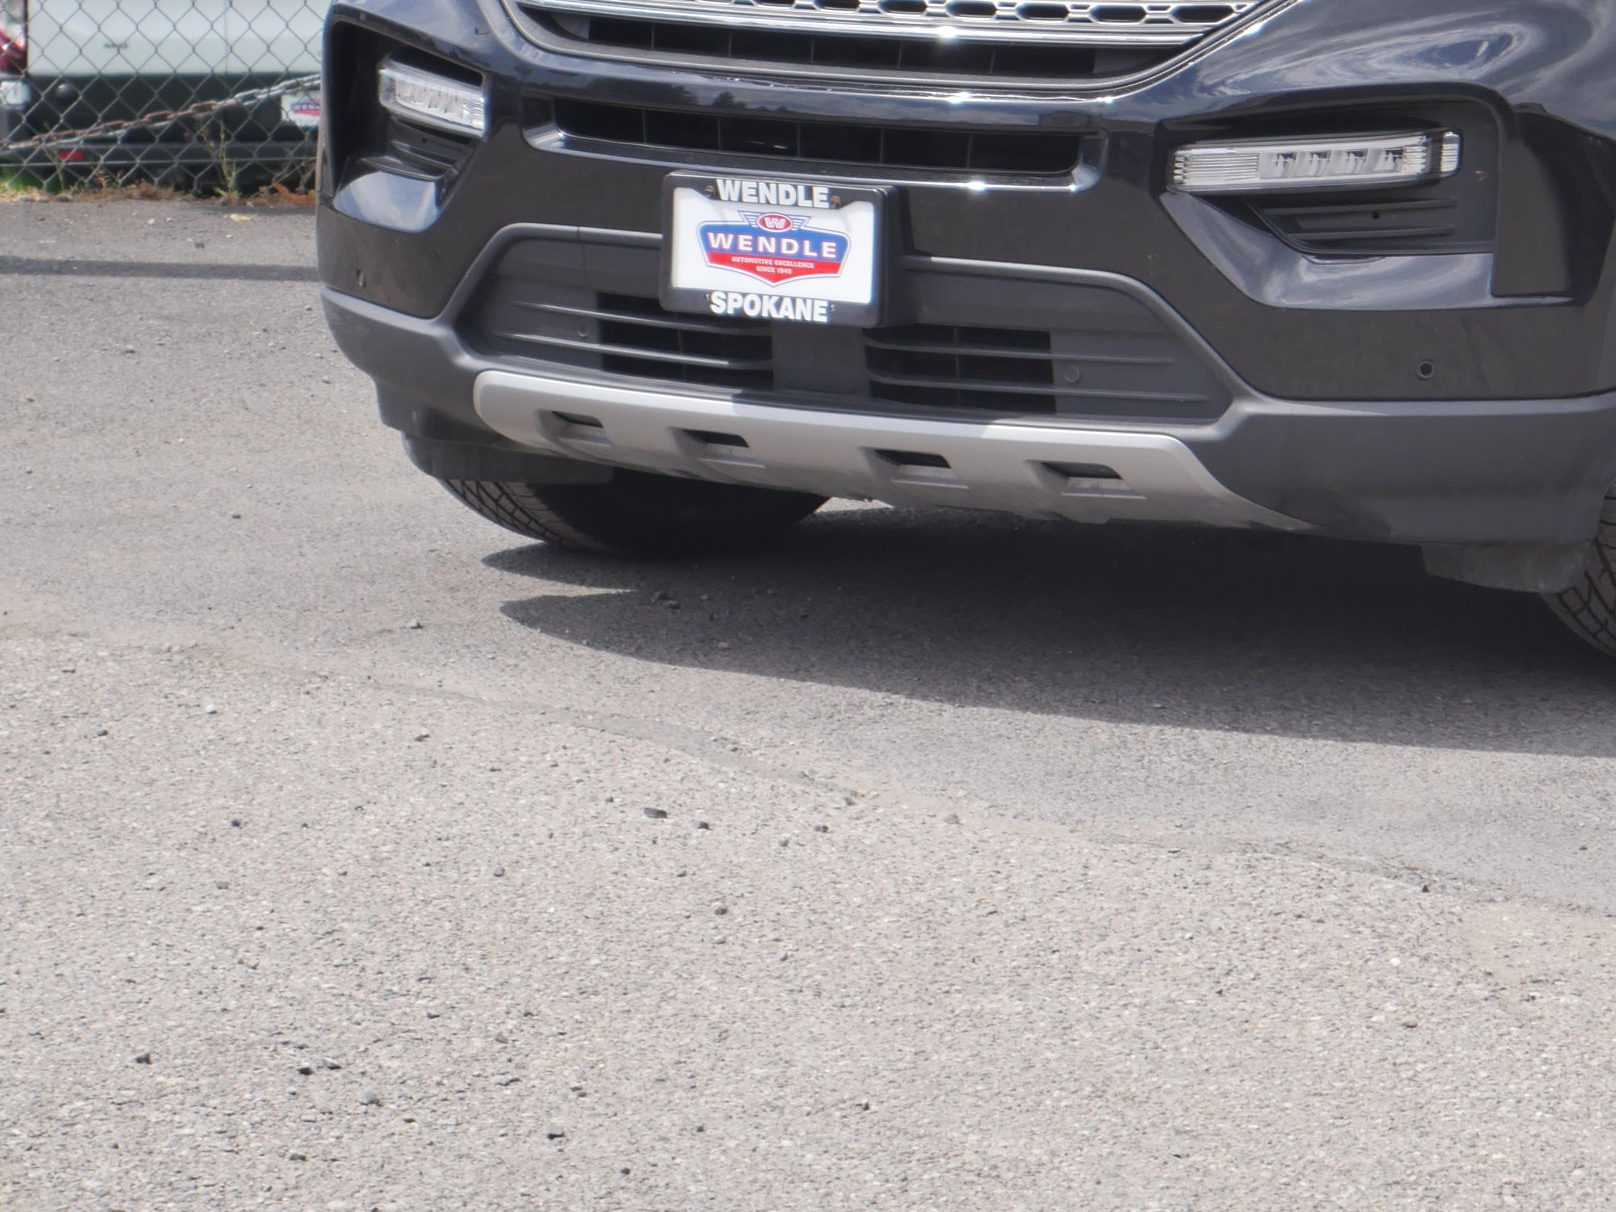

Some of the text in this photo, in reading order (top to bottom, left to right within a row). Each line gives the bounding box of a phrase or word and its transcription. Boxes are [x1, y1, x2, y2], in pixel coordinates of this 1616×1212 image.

[716, 179, 831, 209] WENDLE
[707, 232, 838, 259] WENDLE
[709, 290, 829, 323] SPOKANE
